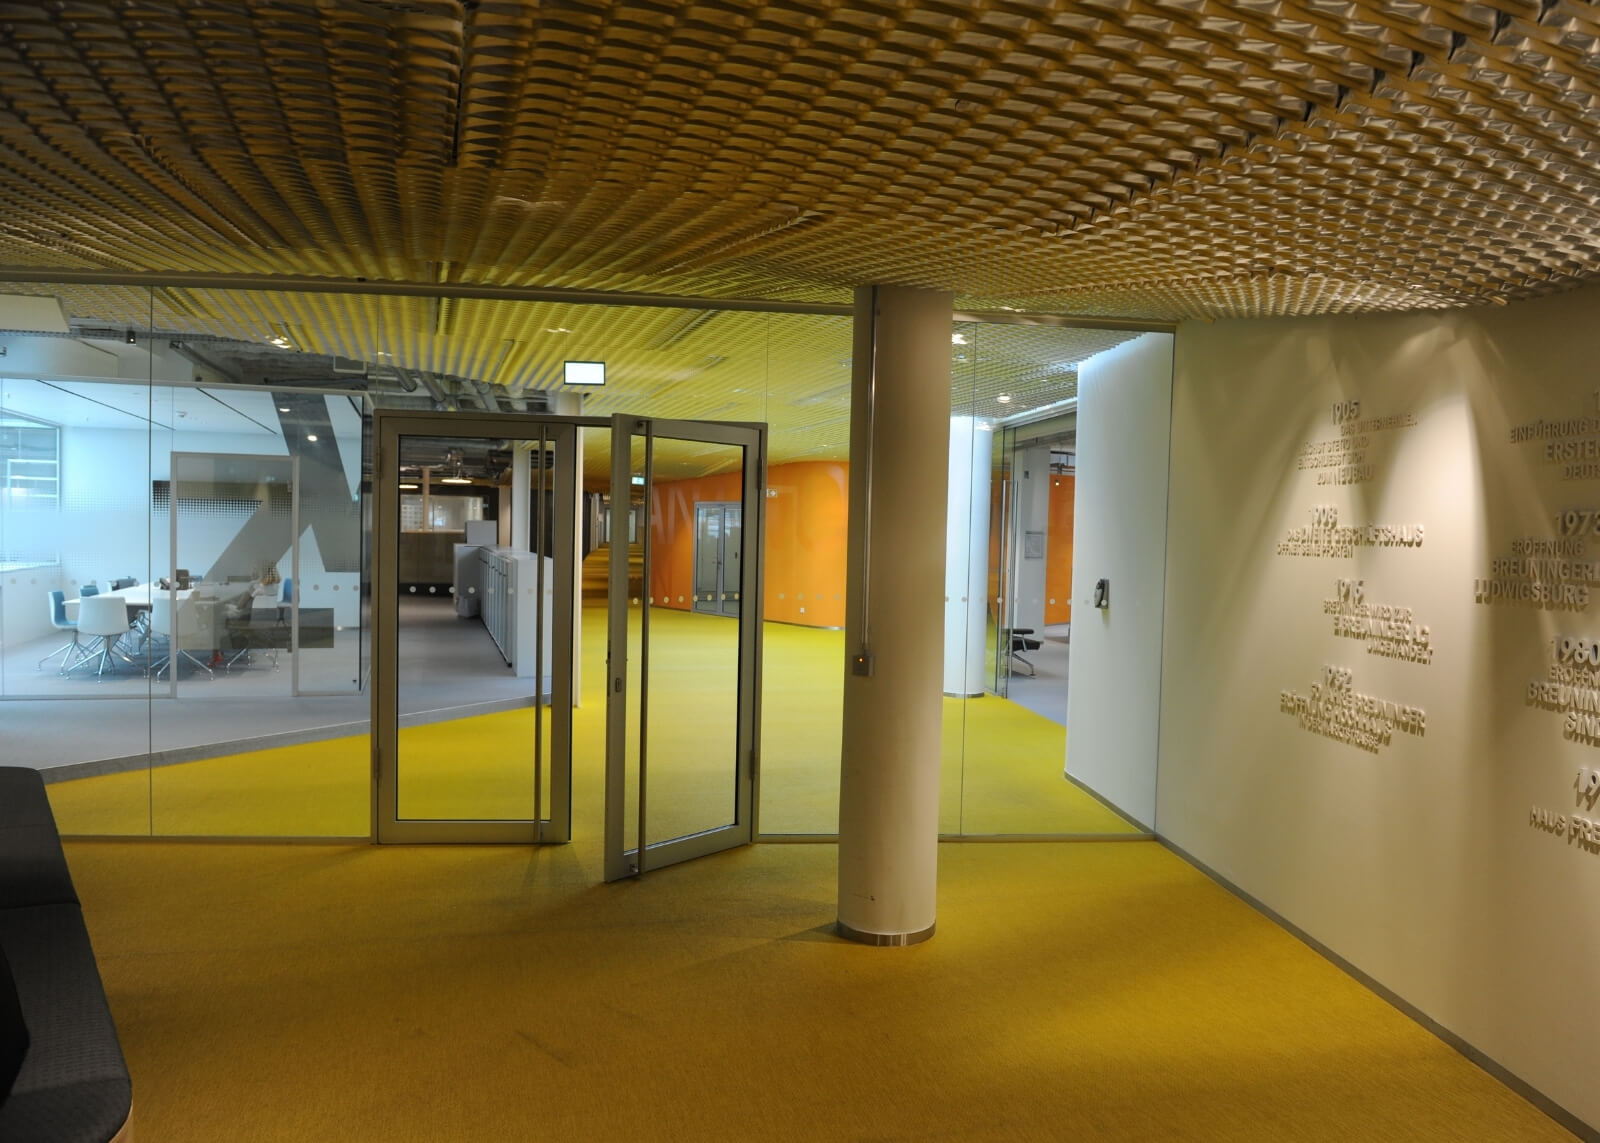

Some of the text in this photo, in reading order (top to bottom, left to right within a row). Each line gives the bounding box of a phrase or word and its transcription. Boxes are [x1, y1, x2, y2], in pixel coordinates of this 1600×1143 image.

[1331, 400, 1360, 425] 1905
[1511, 419, 1588, 444] EINFÜHRUNG
[1511, 537, 1584, 557] ERÖFFNUNG
[1474, 577, 1589, 606] LUDWIGSBURG
[1530, 805, 1565, 832] HAUS
